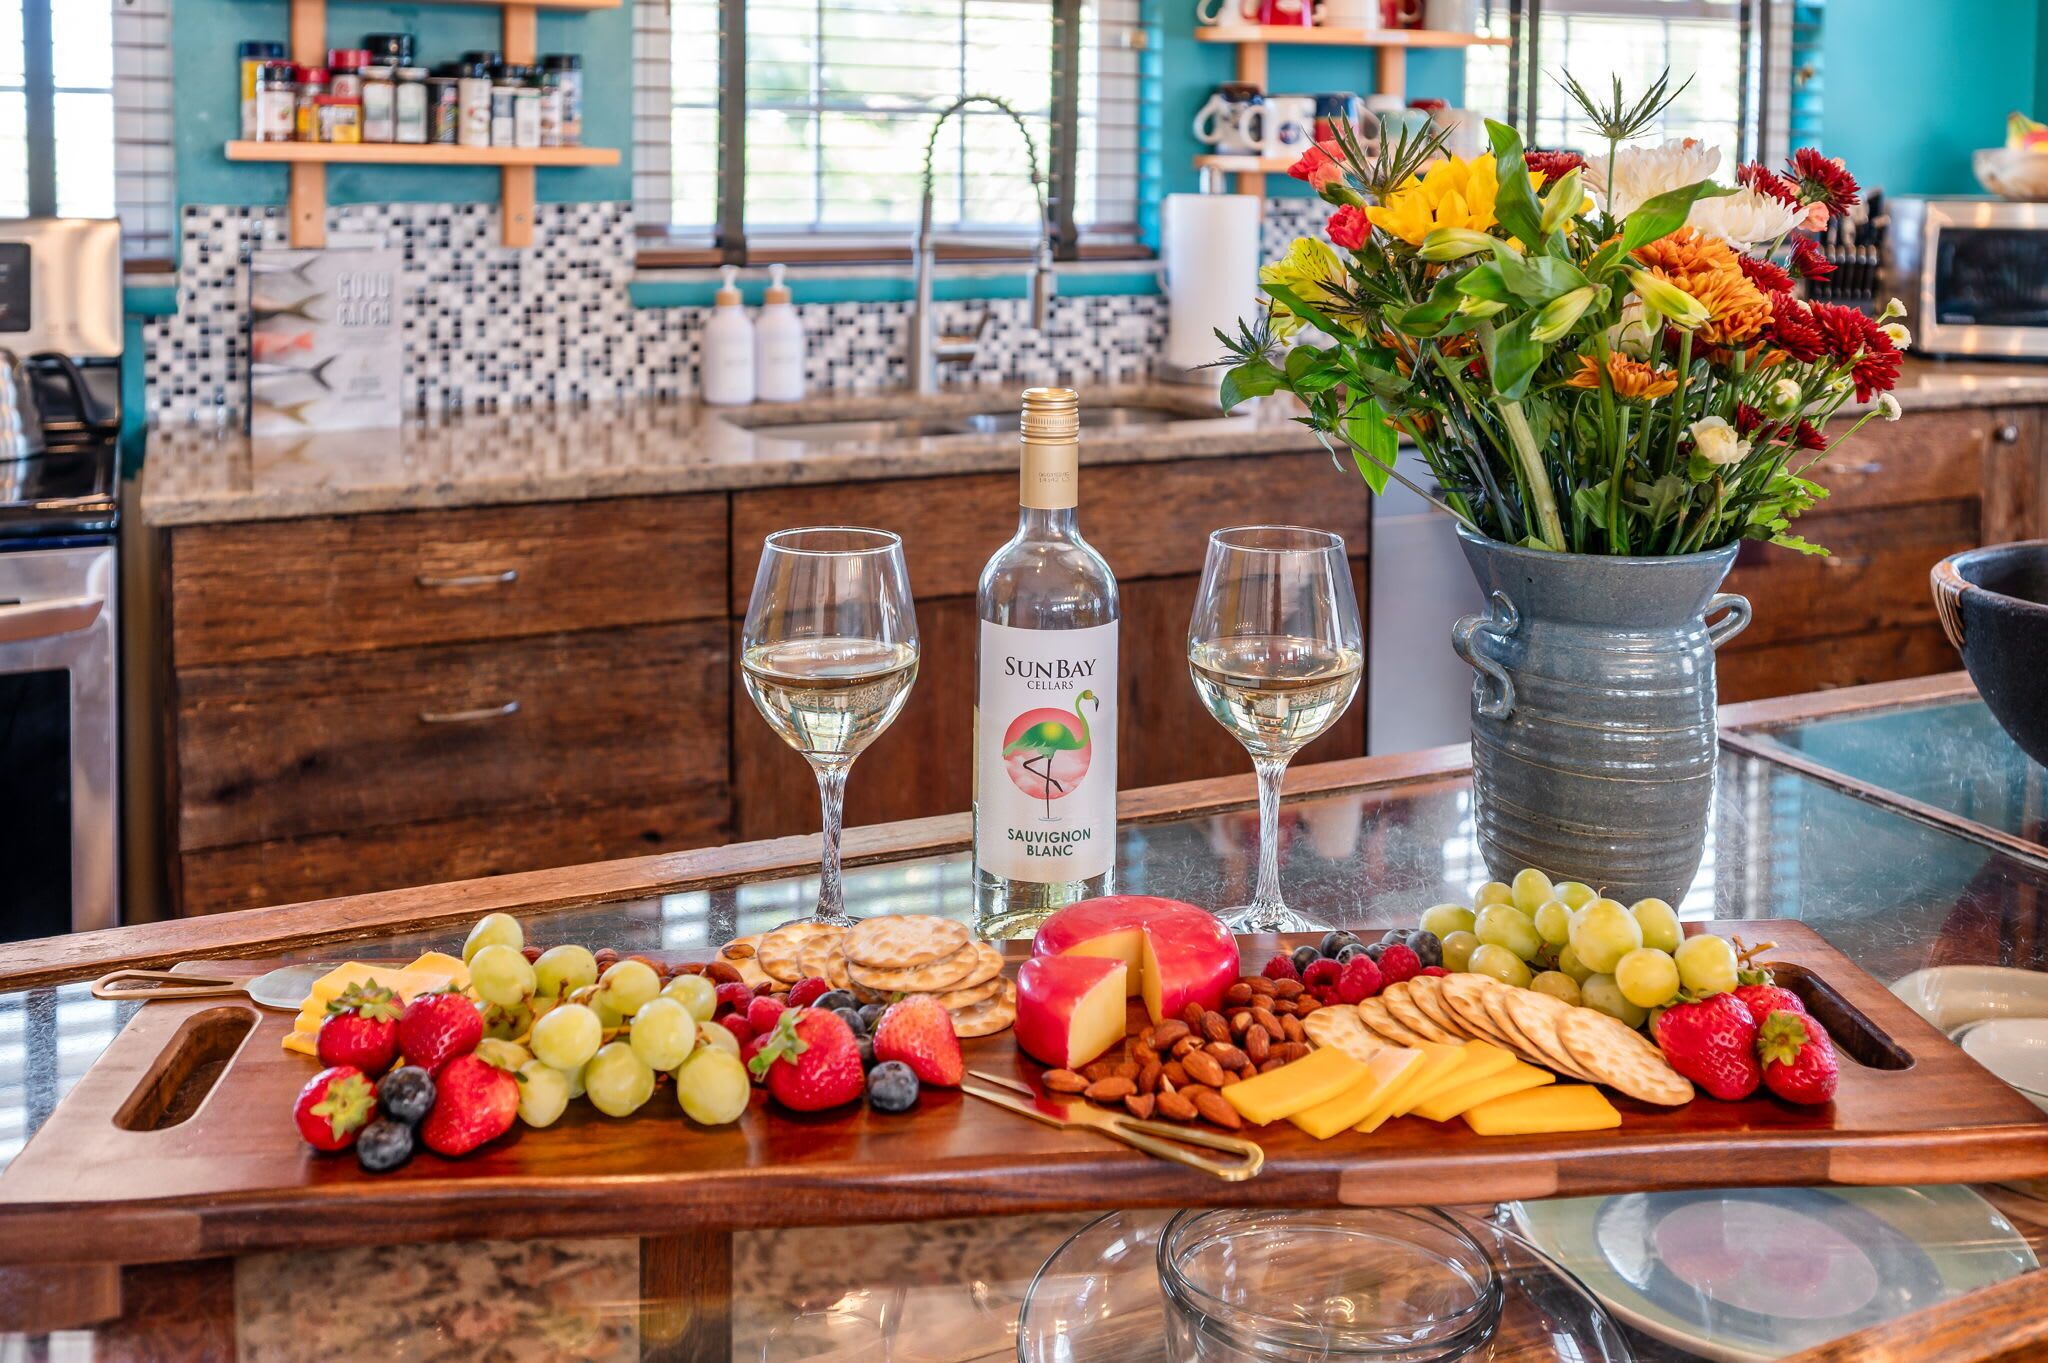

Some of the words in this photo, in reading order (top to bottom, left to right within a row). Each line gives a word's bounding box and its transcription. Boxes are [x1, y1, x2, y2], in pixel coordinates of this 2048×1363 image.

[1027, 680, 1074, 690] CELLARS
[1007, 827, 1091, 844] SAUVIGNON
[1027, 844, 1073, 857] BLANC
